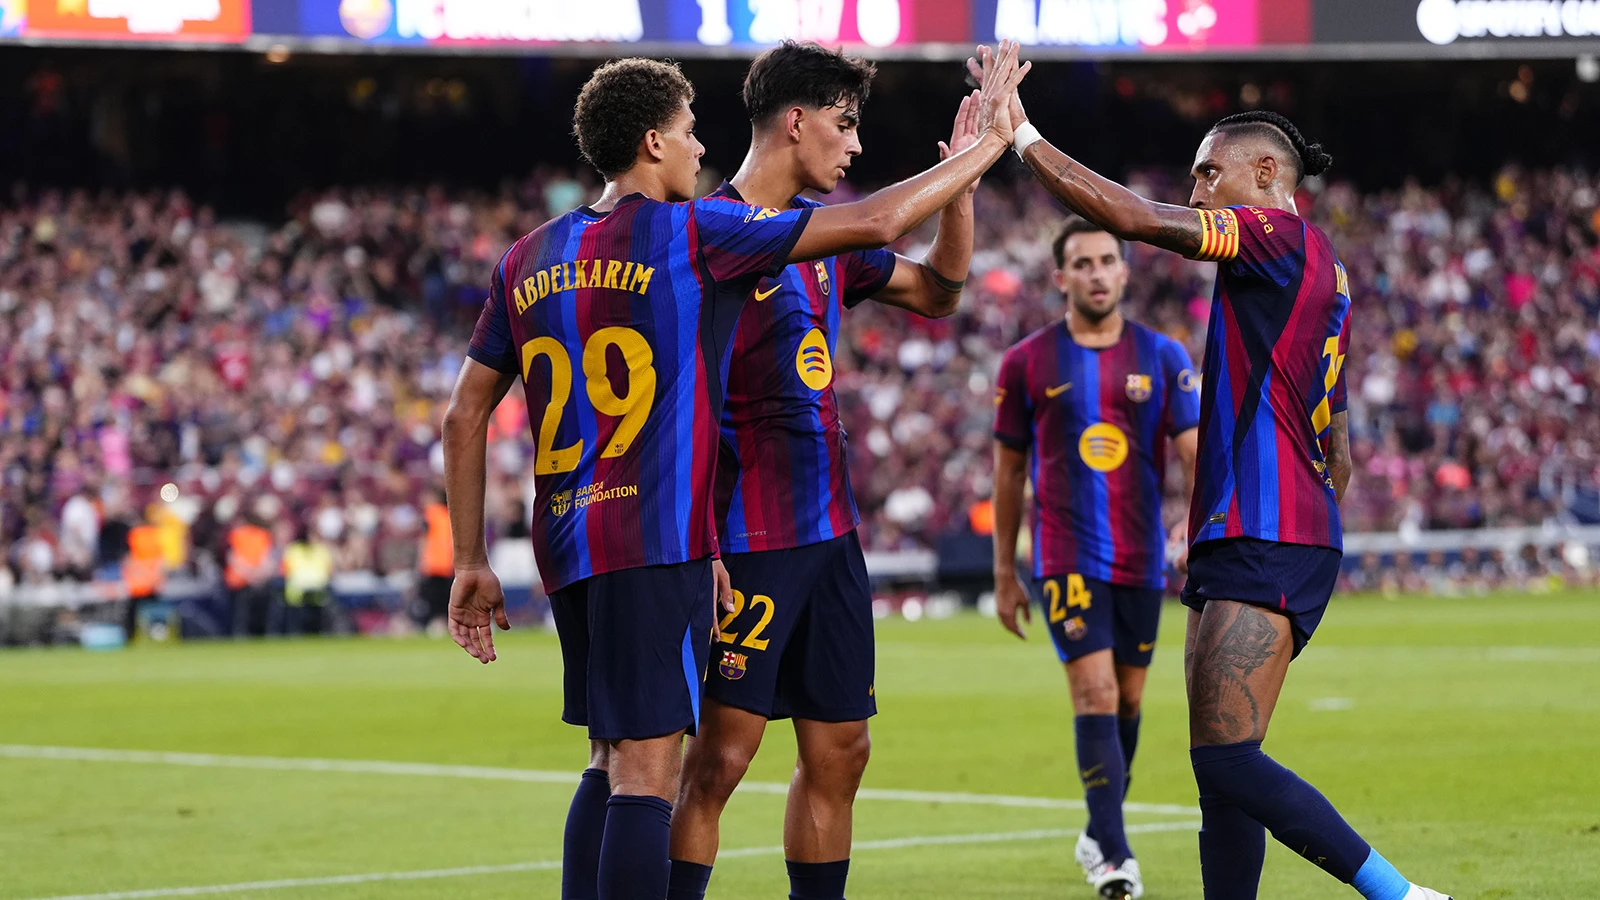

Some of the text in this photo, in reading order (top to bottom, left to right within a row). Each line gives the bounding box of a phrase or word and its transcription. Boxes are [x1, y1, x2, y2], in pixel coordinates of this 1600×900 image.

[513, 259, 655, 316] ABDELKARIM
[521, 326, 657, 475] 29
[574, 485, 638, 510] FOUNDATION
[717, 588, 775, 651] 22
[1043, 573, 1092, 623] 24
